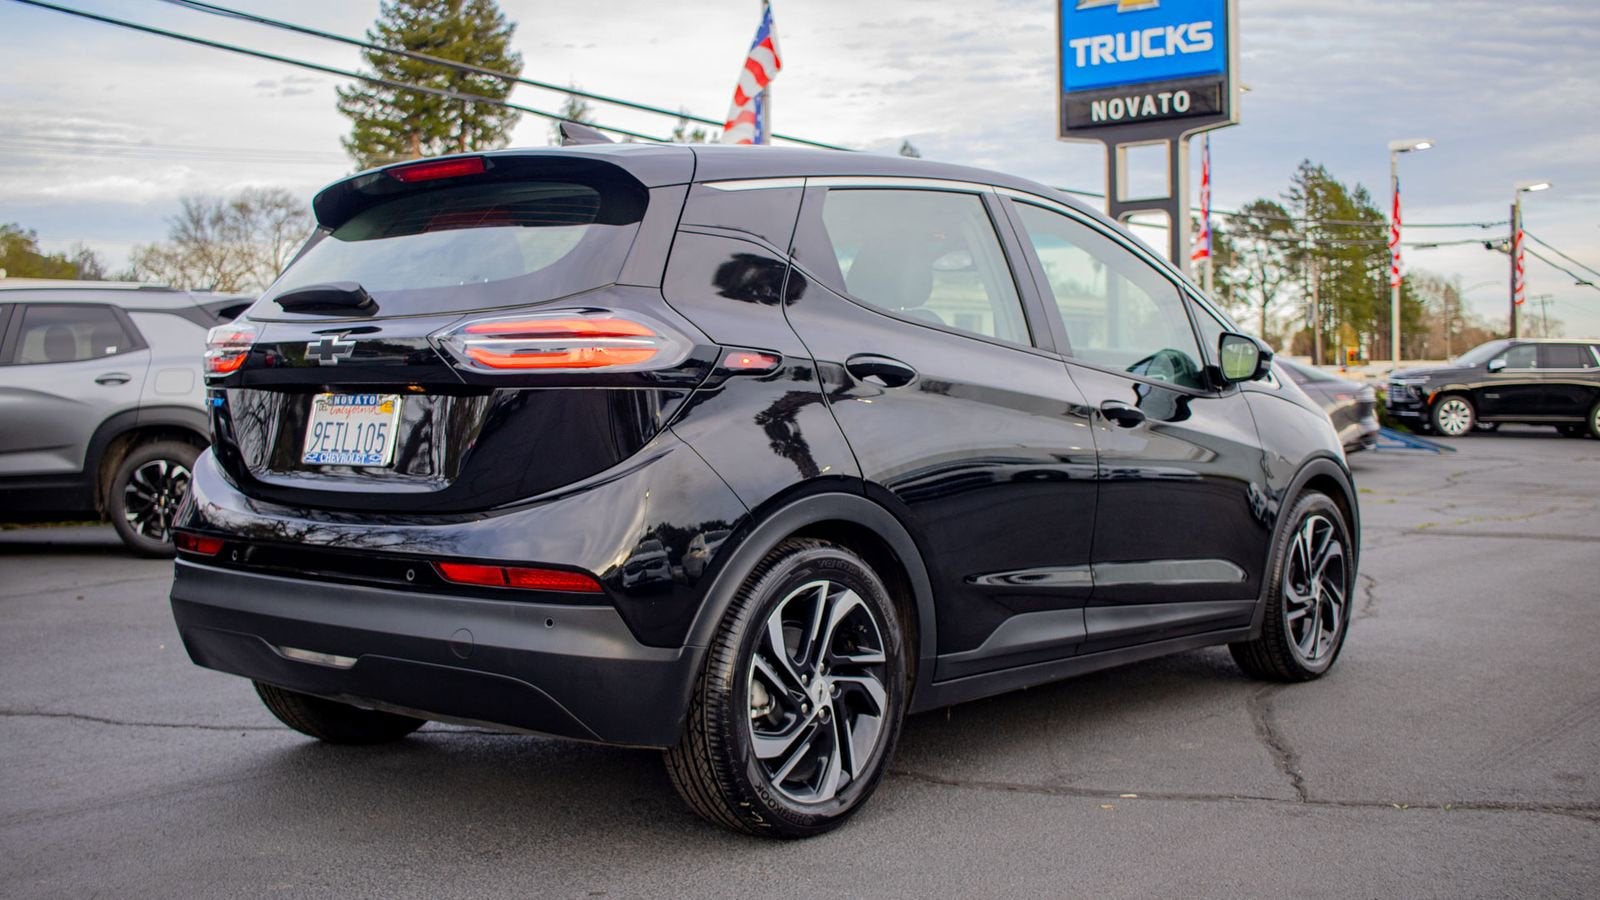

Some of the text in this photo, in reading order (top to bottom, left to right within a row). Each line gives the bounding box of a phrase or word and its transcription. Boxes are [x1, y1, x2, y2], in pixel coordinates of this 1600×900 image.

[1068, 21, 1214, 67] TRUCKS
[1091, 90, 1191, 122] NOVATO
[335, 396, 376, 405] NOVATO
[309, 421, 387, 454] 9EIL105
[320, 452, 366, 463] CHEVROLET
